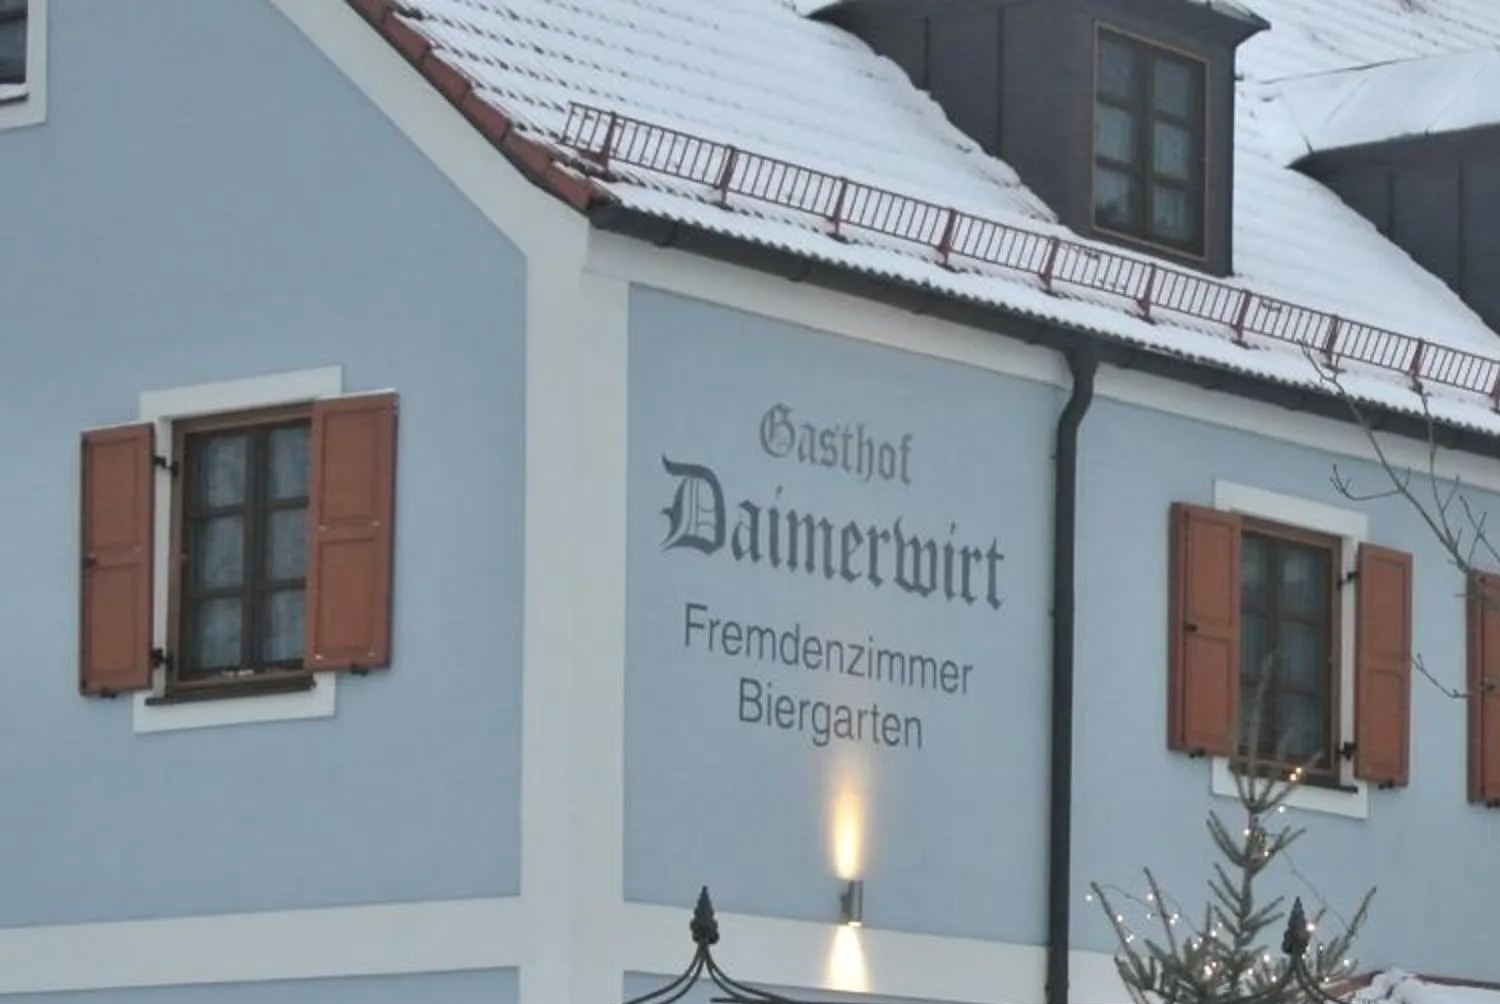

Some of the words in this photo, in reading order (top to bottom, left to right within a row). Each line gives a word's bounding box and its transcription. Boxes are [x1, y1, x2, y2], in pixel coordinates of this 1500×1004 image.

[760, 402, 913, 485] Gasthof
[659, 452, 1005, 611] Daimerwirt
[685, 602, 974, 694] Fremdenzimmer
[738, 677, 922, 750] Biergarten
